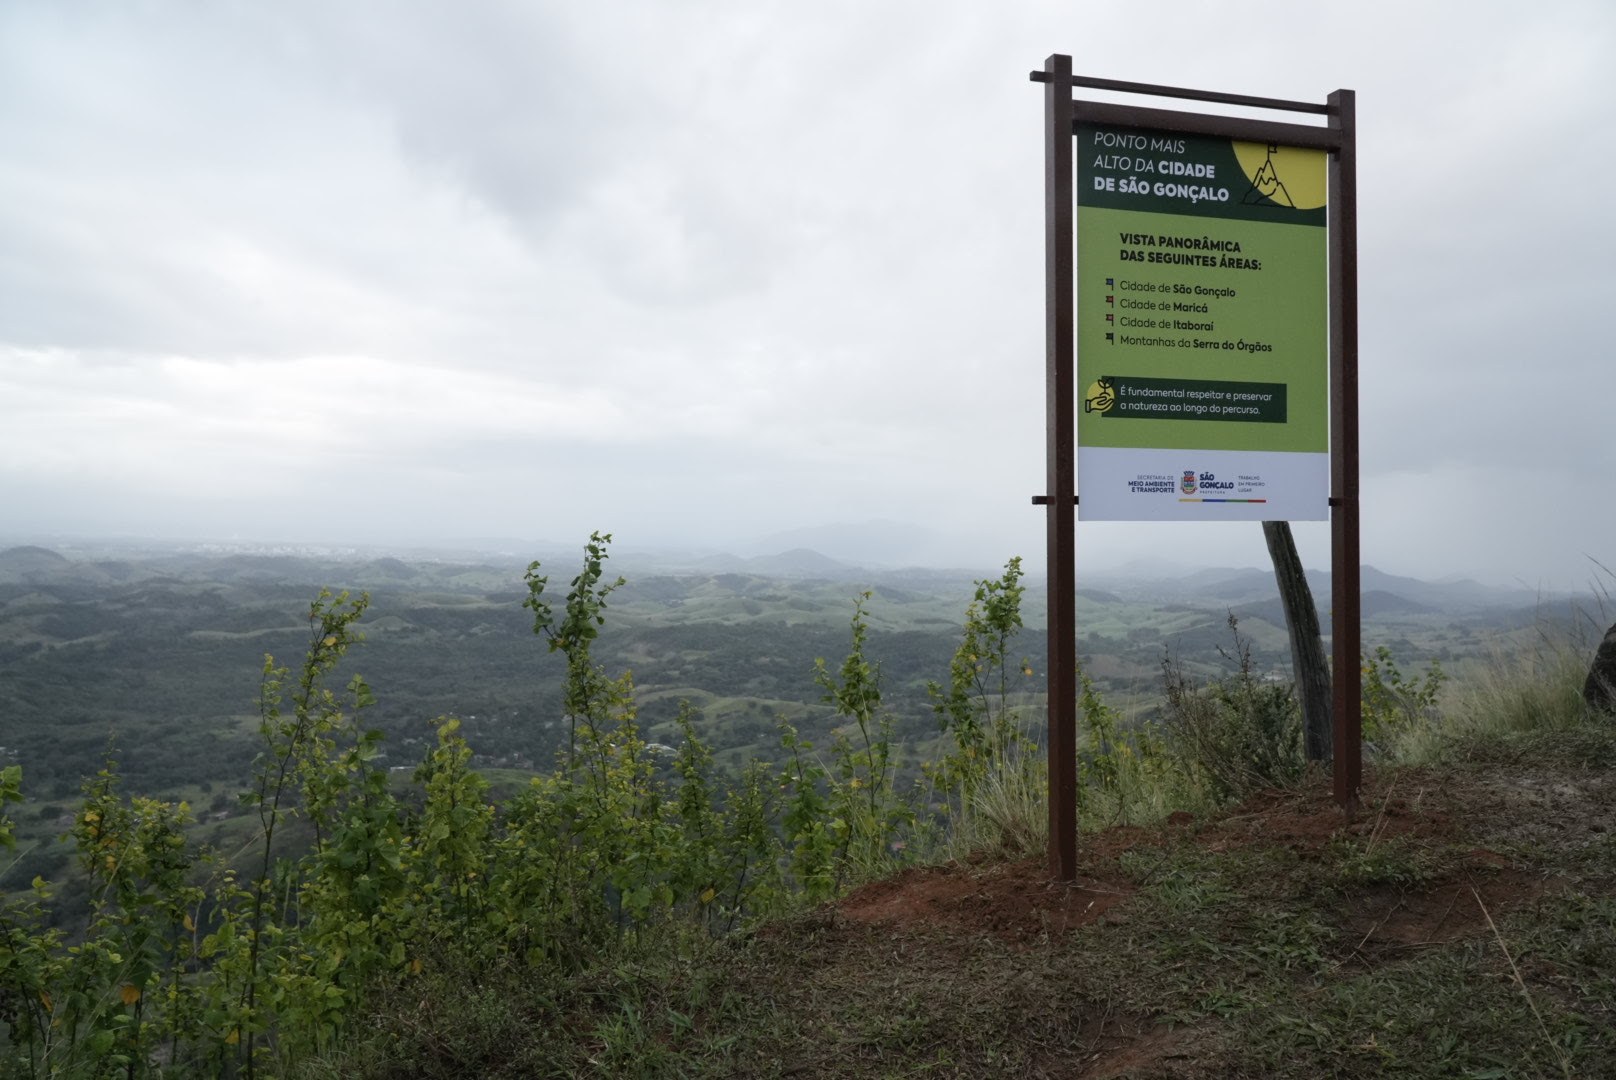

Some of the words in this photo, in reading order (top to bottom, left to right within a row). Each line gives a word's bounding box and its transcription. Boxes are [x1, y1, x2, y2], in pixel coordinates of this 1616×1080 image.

[1094, 132, 1147, 149] PONTO
[1150, 138, 1185, 154] MAIS
[1093, 155, 1131, 170] ALTO
[1135, 159, 1154, 173] DA
[1158, 161, 1215, 178] CIDADE
[1094, 177, 1115, 191] DE
[1119, 176, 1149, 194] SÃO
[1154, 183, 1229, 203] GONÇALO
[1120, 233, 1156, 246] VISTA
[1159, 236, 1240, 252] PANORÂMICA
[1120, 250, 1144, 262] DAS
[1148, 252, 1216, 267] SEGUINTES
[1220, 254, 1261, 270] ÁREAS:
[1120, 281, 1156, 292] Cidade
[1158, 283, 1170, 293] de
[1173, 284, 1192, 294] São
[1194, 286, 1235, 299] Gonçalo
[1120, 299, 1156, 310] Cidade
[1159, 301, 1171, 310] de
[1173, 302, 1208, 313] Maricá
[1120, 317, 1156, 328] Cidade
[1159, 319, 1171, 328] de
[1174, 320, 1214, 331] Itaboraí
[1120, 336, 1175, 347] Montanhas
[1178, 338, 1190, 348] da
[1193, 339, 1219, 349] Serra
[1222, 340, 1234, 350] do
[1237, 339, 1272, 353] Órgãos
[1120, 385, 1126, 395] É
[1128, 387, 1184, 398] fundamental
[1187, 389, 1224, 401] respeitar
[1234, 392, 1272, 401] preservar
[1129, 403, 1168, 411] natureza
[1184, 403, 1207, 414] longo
[1223, 406, 1260, 414] percurso.
[1200, 472, 1214, 480] SÃO
